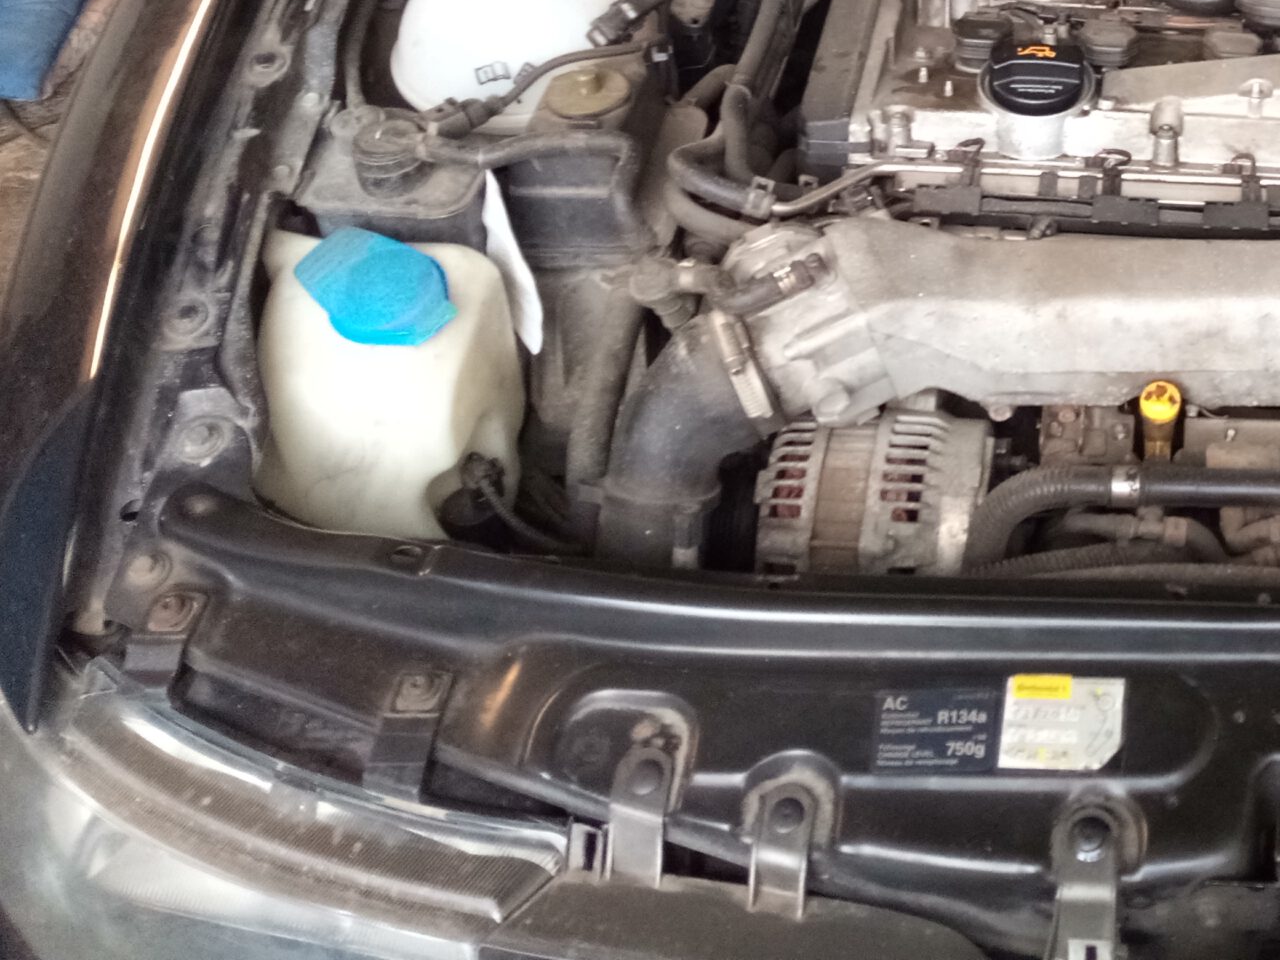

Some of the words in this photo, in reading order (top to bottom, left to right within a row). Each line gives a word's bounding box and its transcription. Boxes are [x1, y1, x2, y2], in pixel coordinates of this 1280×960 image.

[882, 696, 908, 710] AC
[937, 709, 987, 724] R134a
[945, 741, 986, 758] 750g
